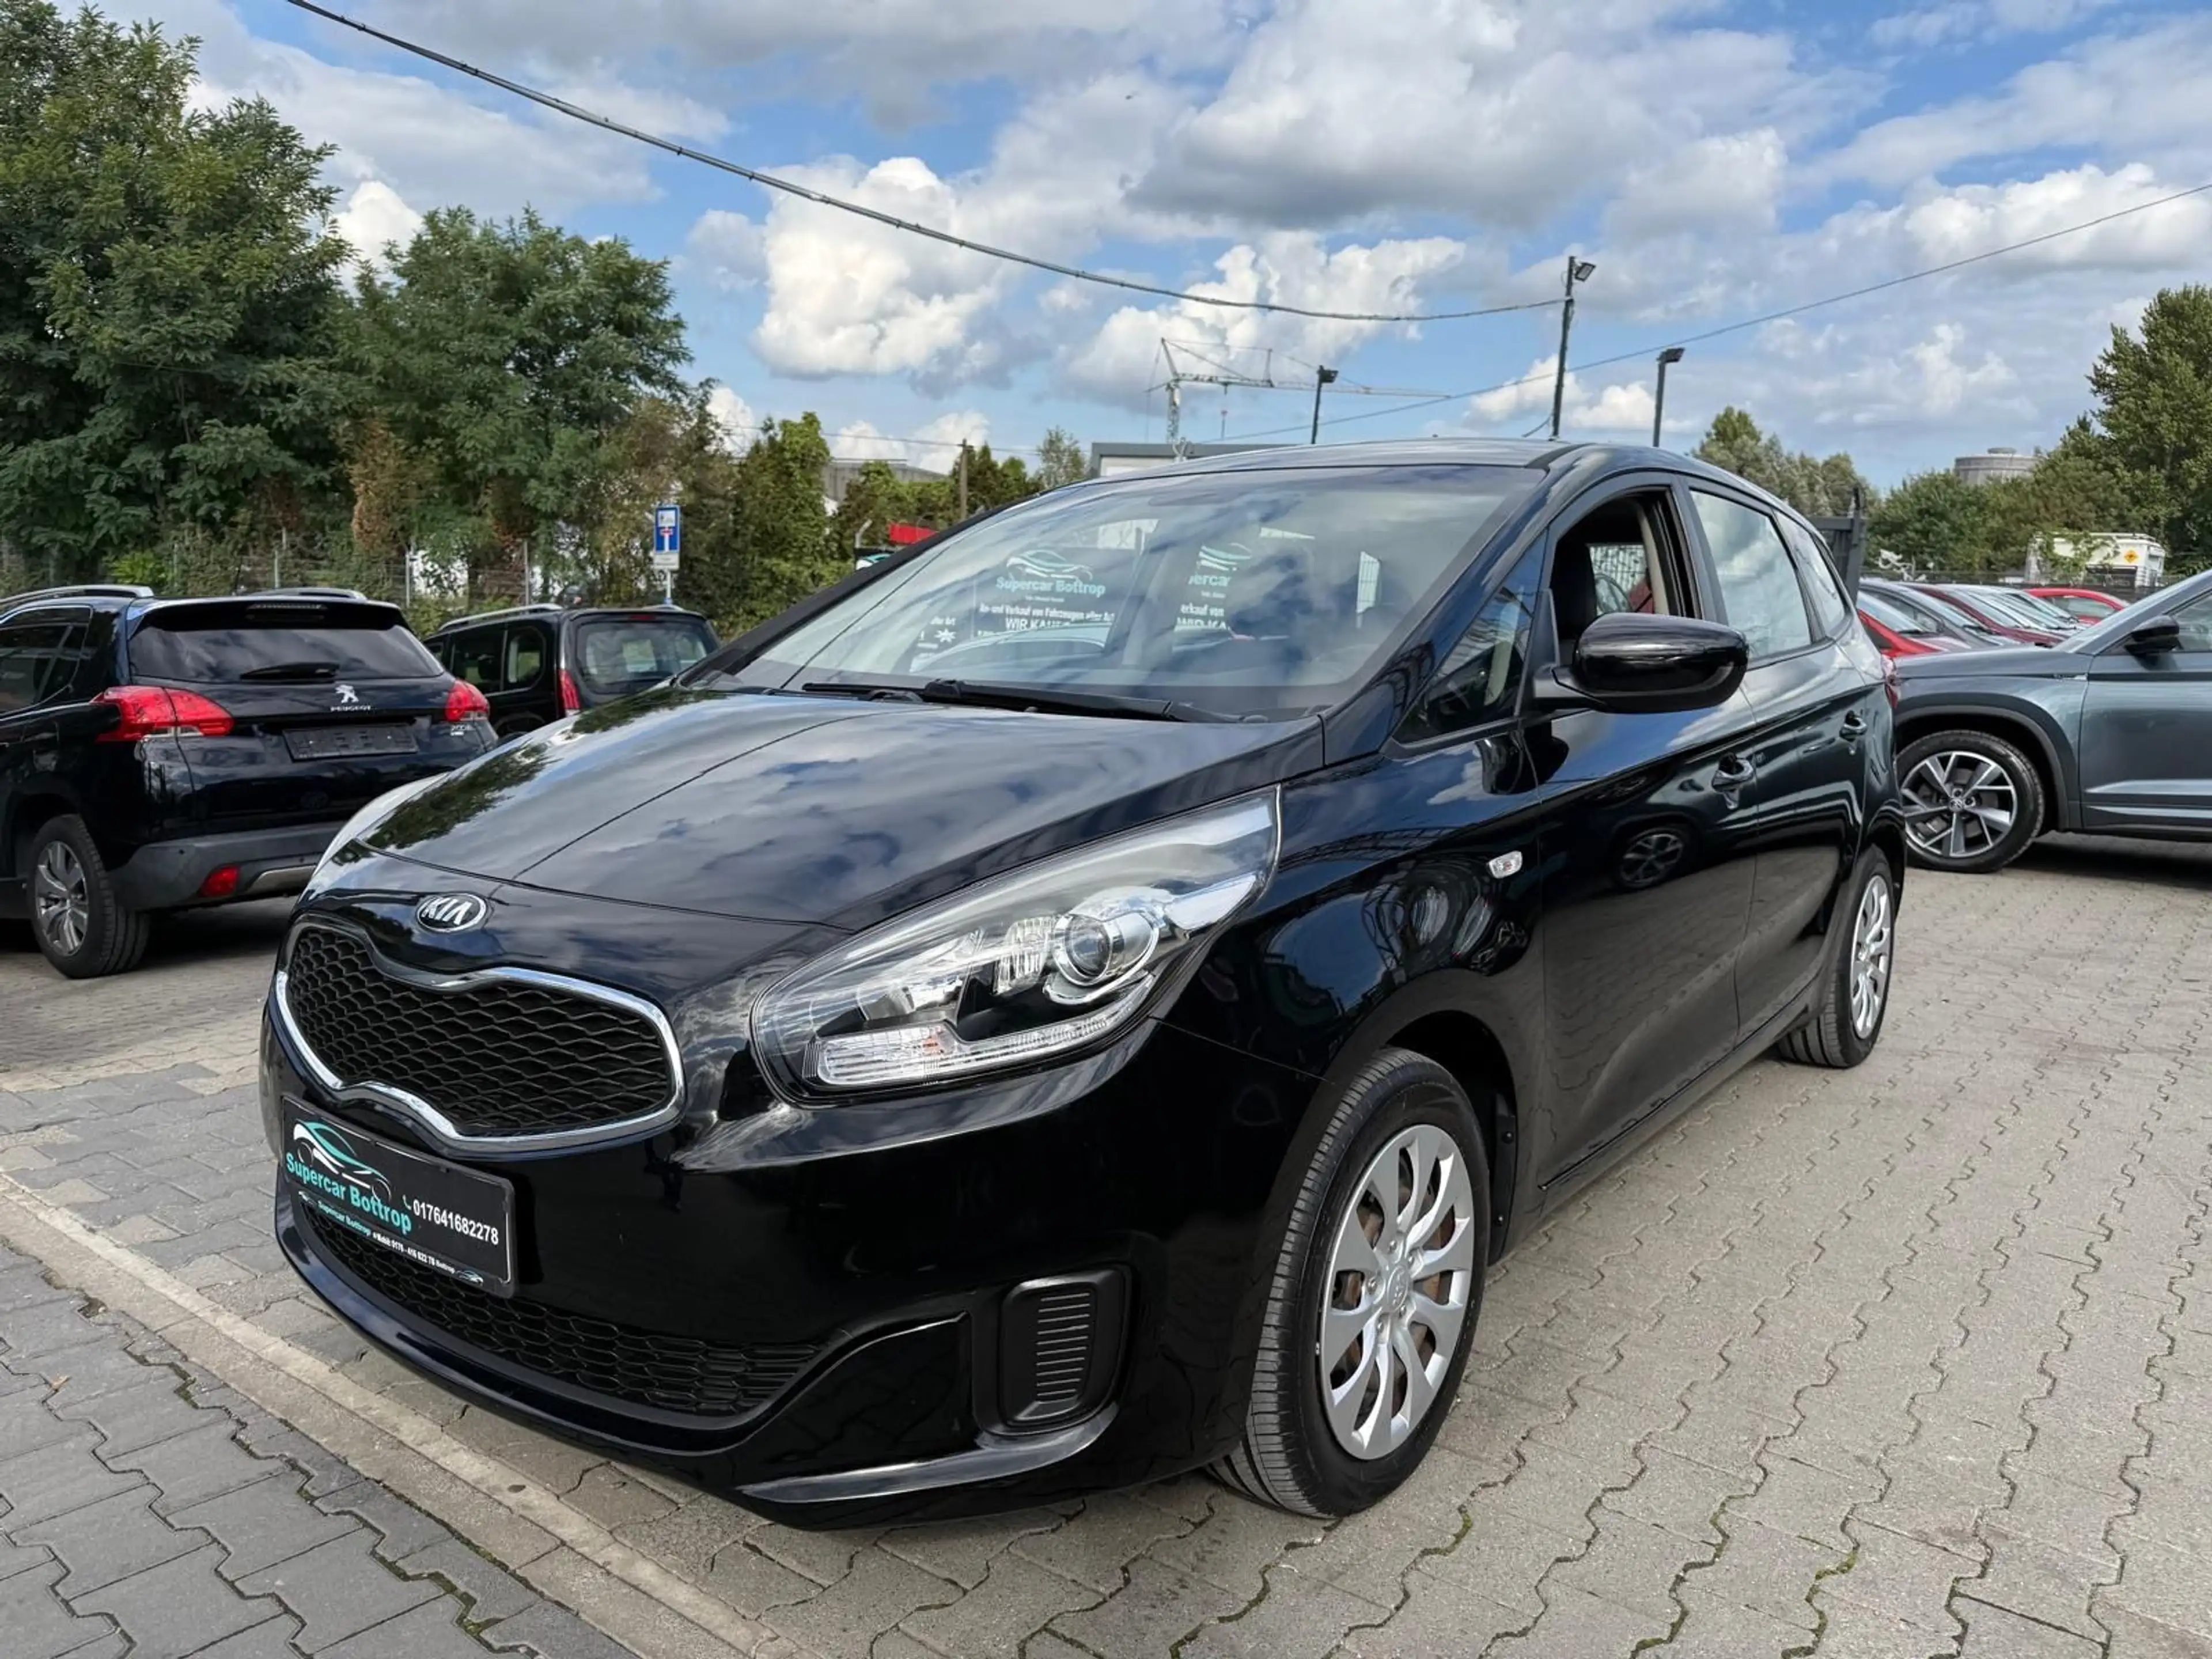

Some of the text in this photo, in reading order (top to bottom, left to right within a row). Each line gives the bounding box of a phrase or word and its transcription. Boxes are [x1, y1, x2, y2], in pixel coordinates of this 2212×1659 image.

[995, 576, 1106, 598] Supercar Bottrop
[1005, 618, 1028, 631] WIR
[421, 897, 473, 926] KIA
[286, 1152, 413, 1235] Supercar Bottrop
[413, 1198, 499, 1246] 017641682278
